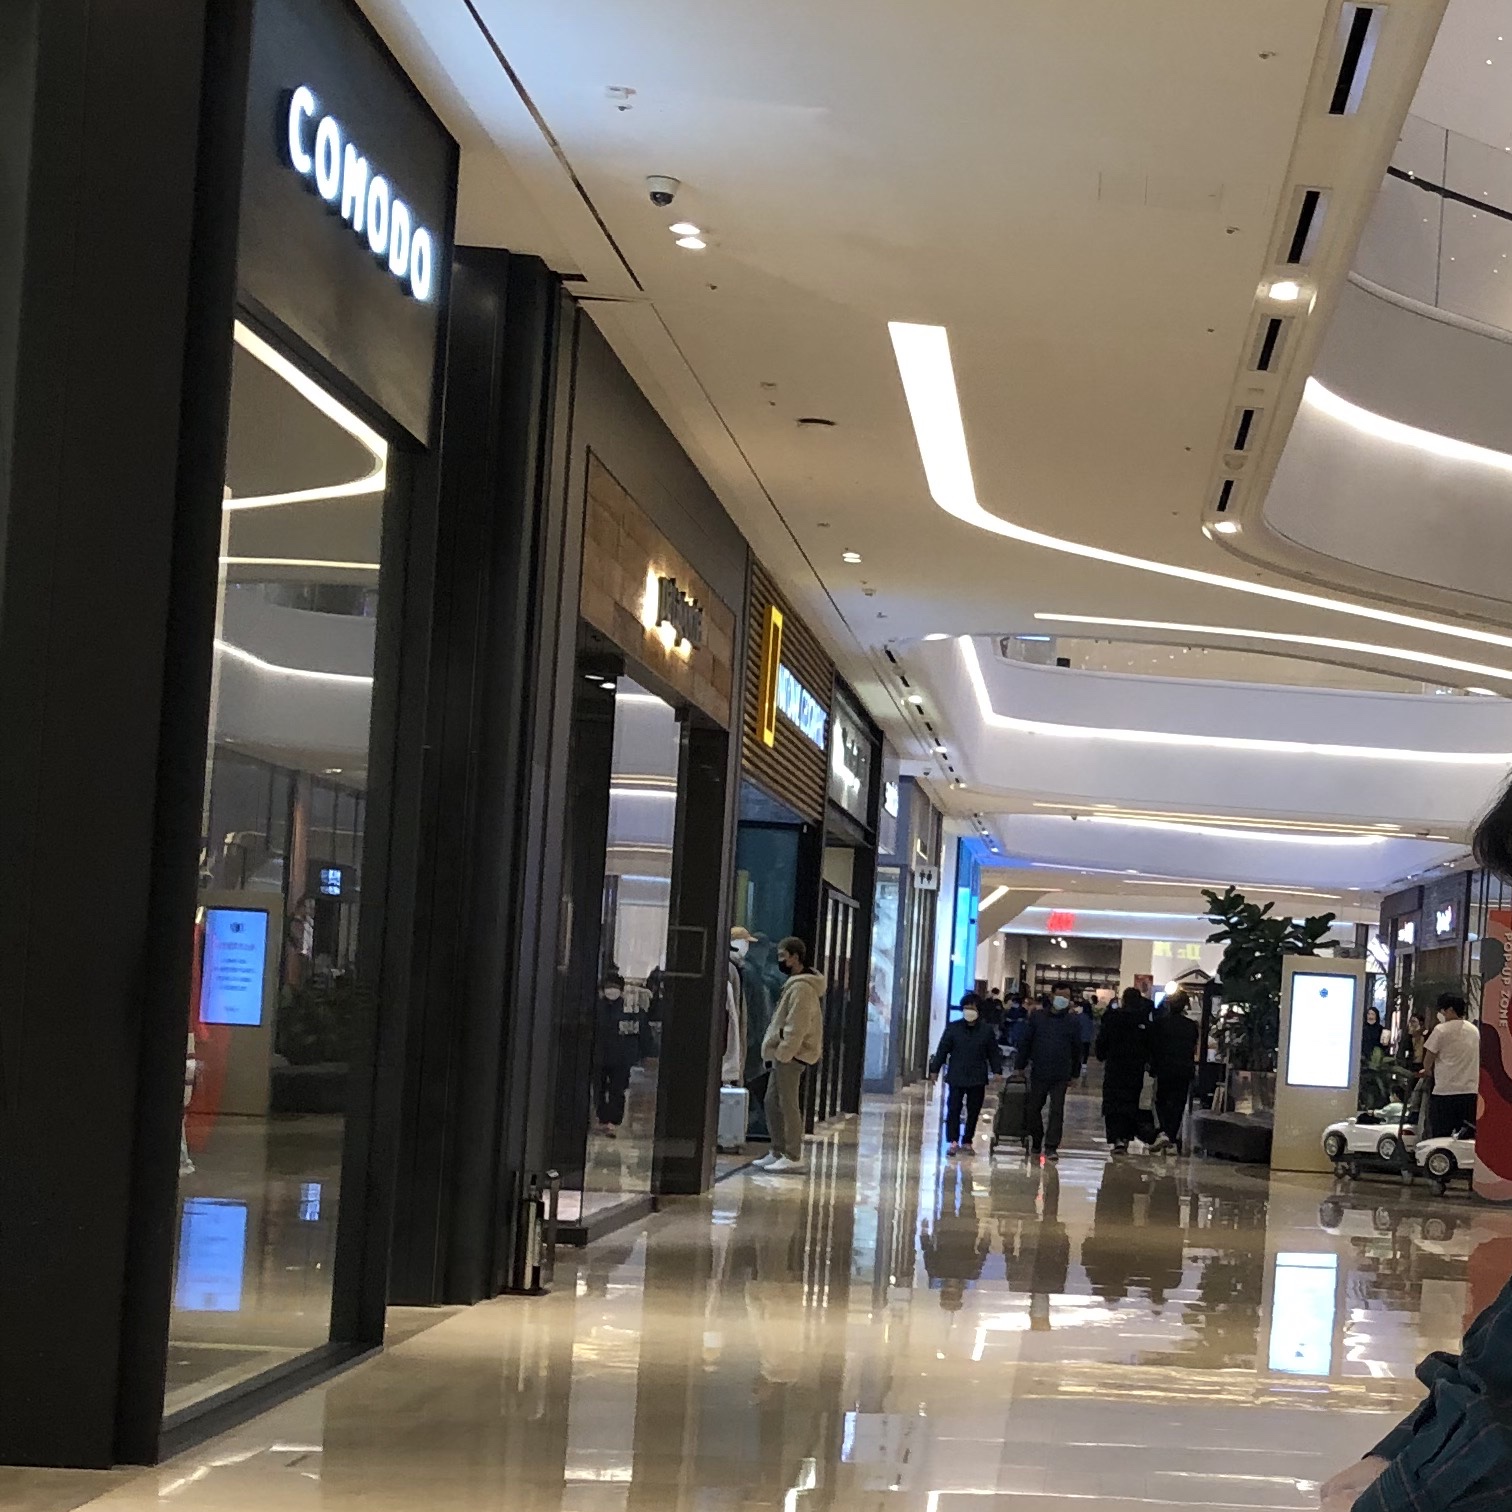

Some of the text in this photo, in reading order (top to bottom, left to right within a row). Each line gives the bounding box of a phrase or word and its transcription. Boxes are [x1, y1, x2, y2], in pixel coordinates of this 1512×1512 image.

[289, 86, 431, 300] COMODO
[1499, 932, 1512, 1028] POP-UP ZONE
